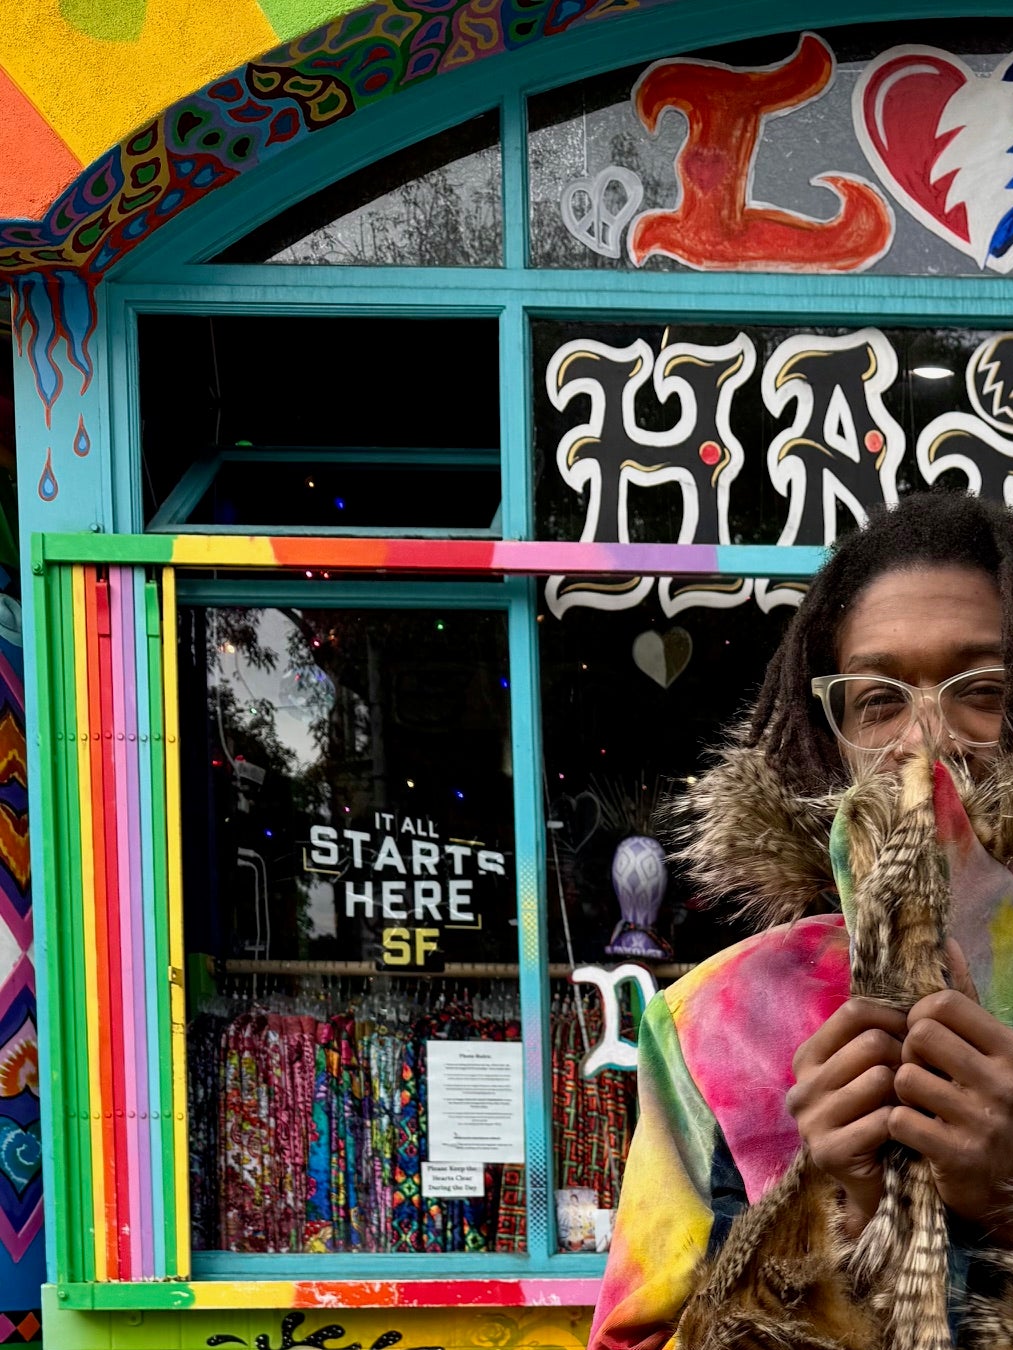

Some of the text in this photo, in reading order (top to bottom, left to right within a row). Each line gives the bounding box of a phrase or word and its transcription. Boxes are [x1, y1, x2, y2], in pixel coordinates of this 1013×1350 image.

[375, 812, 439, 838] IT ALL
[310, 825, 506, 875] STARTS
[345, 879, 474, 921] HERE
[382, 927, 440, 966] SF
